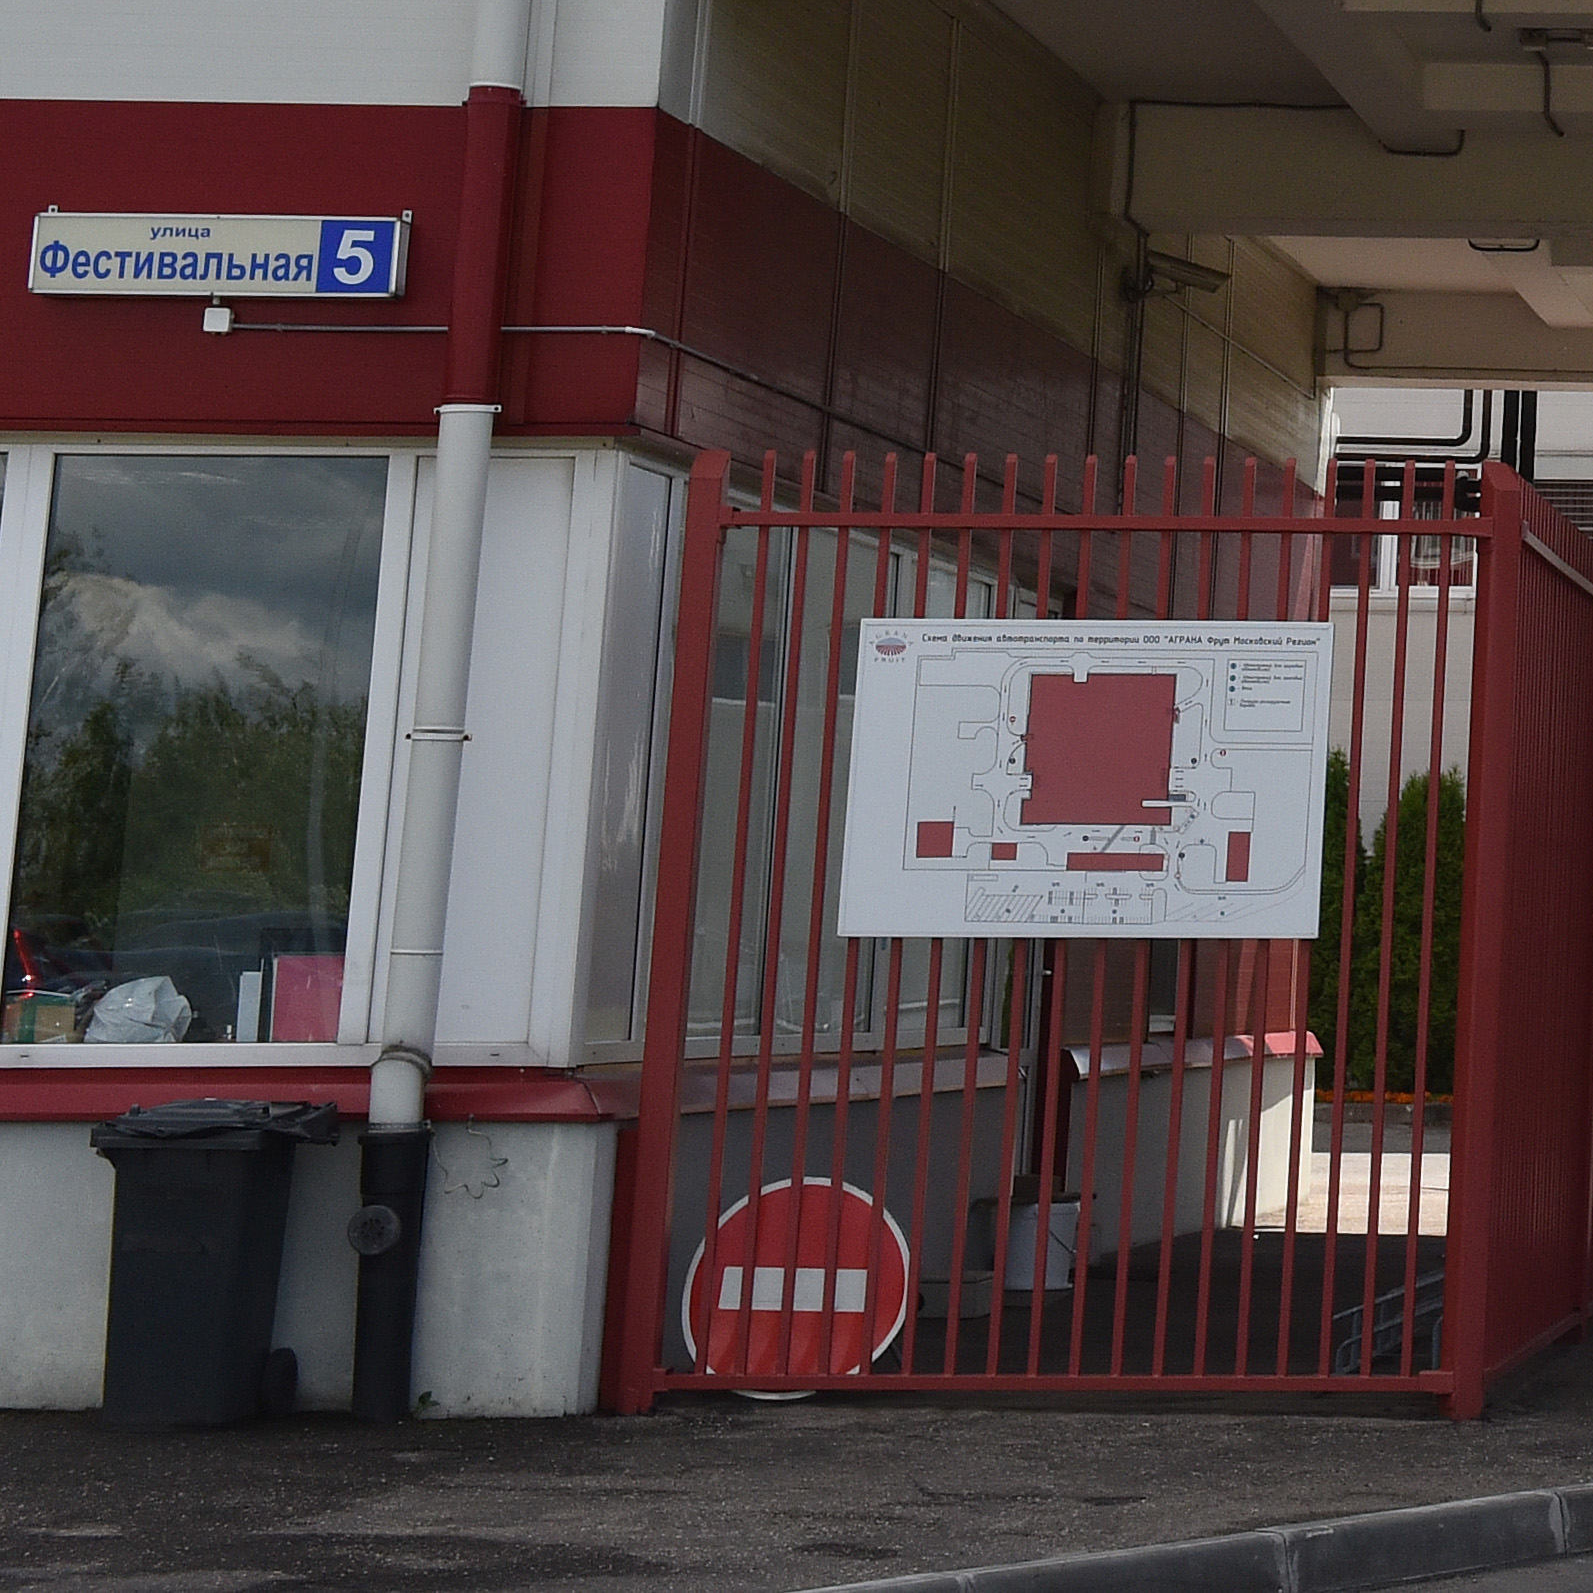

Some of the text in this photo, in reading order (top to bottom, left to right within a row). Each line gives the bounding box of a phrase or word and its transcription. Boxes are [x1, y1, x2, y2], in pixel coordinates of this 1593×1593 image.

[150, 224, 211, 240] улица
[39, 229, 375, 286] Фестивальная 5
[921, 633, 948, 643] Схема
[952, 634, 993, 643] движения
[996, 634, 1070, 644] автотранспорта
[1087, 636, 1140, 645] территории
[1143, 635, 1160, 644] ООО
[1164, 635, 1203, 644] "АГРАНА
[1206, 636, 1230, 646] Фрут
[1233, 637, 1283, 646] Московский
